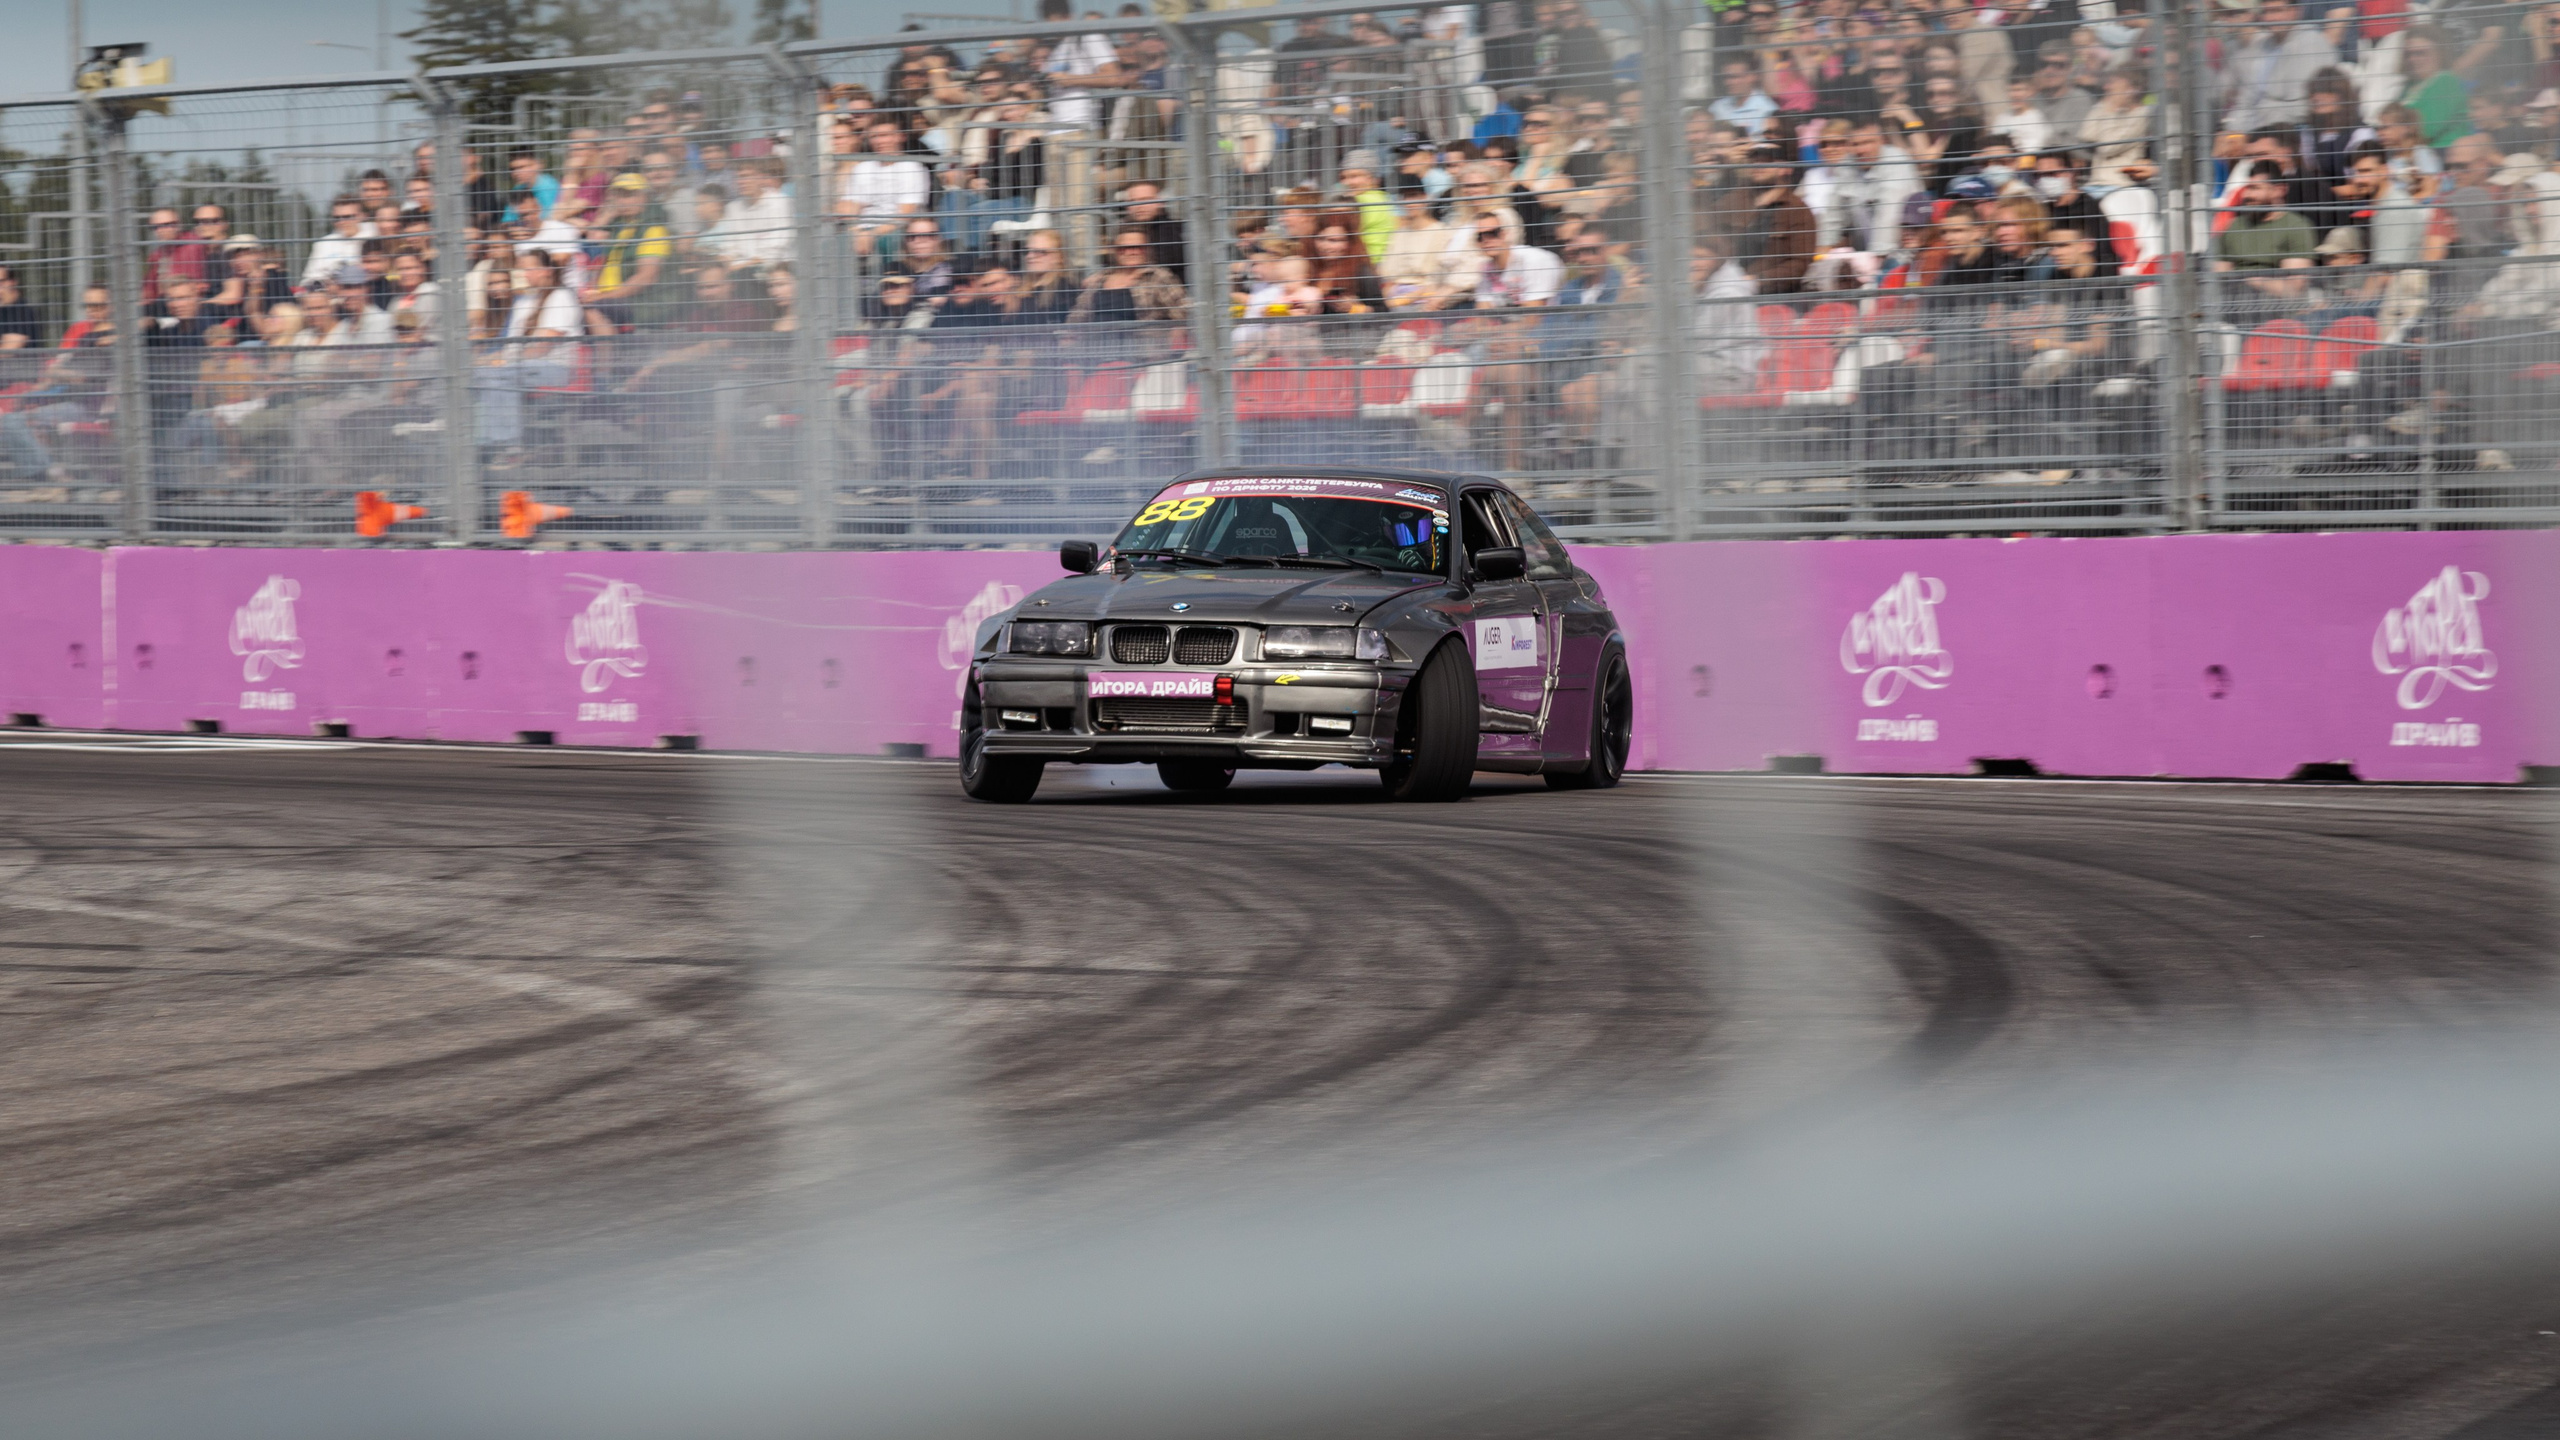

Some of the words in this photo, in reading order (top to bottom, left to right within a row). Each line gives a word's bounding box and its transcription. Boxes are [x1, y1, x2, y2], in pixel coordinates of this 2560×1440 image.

[1260, 478, 1384, 490] САНКТ-ПЕТЕРБУРГА
[1134, 496, 1216, 526] 88
[1235, 527, 1277, 537] sparco
[1091, 681, 1147, 695] ИГОРА
[1151, 678, 1214, 697] ДРАЙВ
[1856, 713, 1939, 741] ДРАЙВ
[2389, 717, 2482, 747] ДРАЙВ
